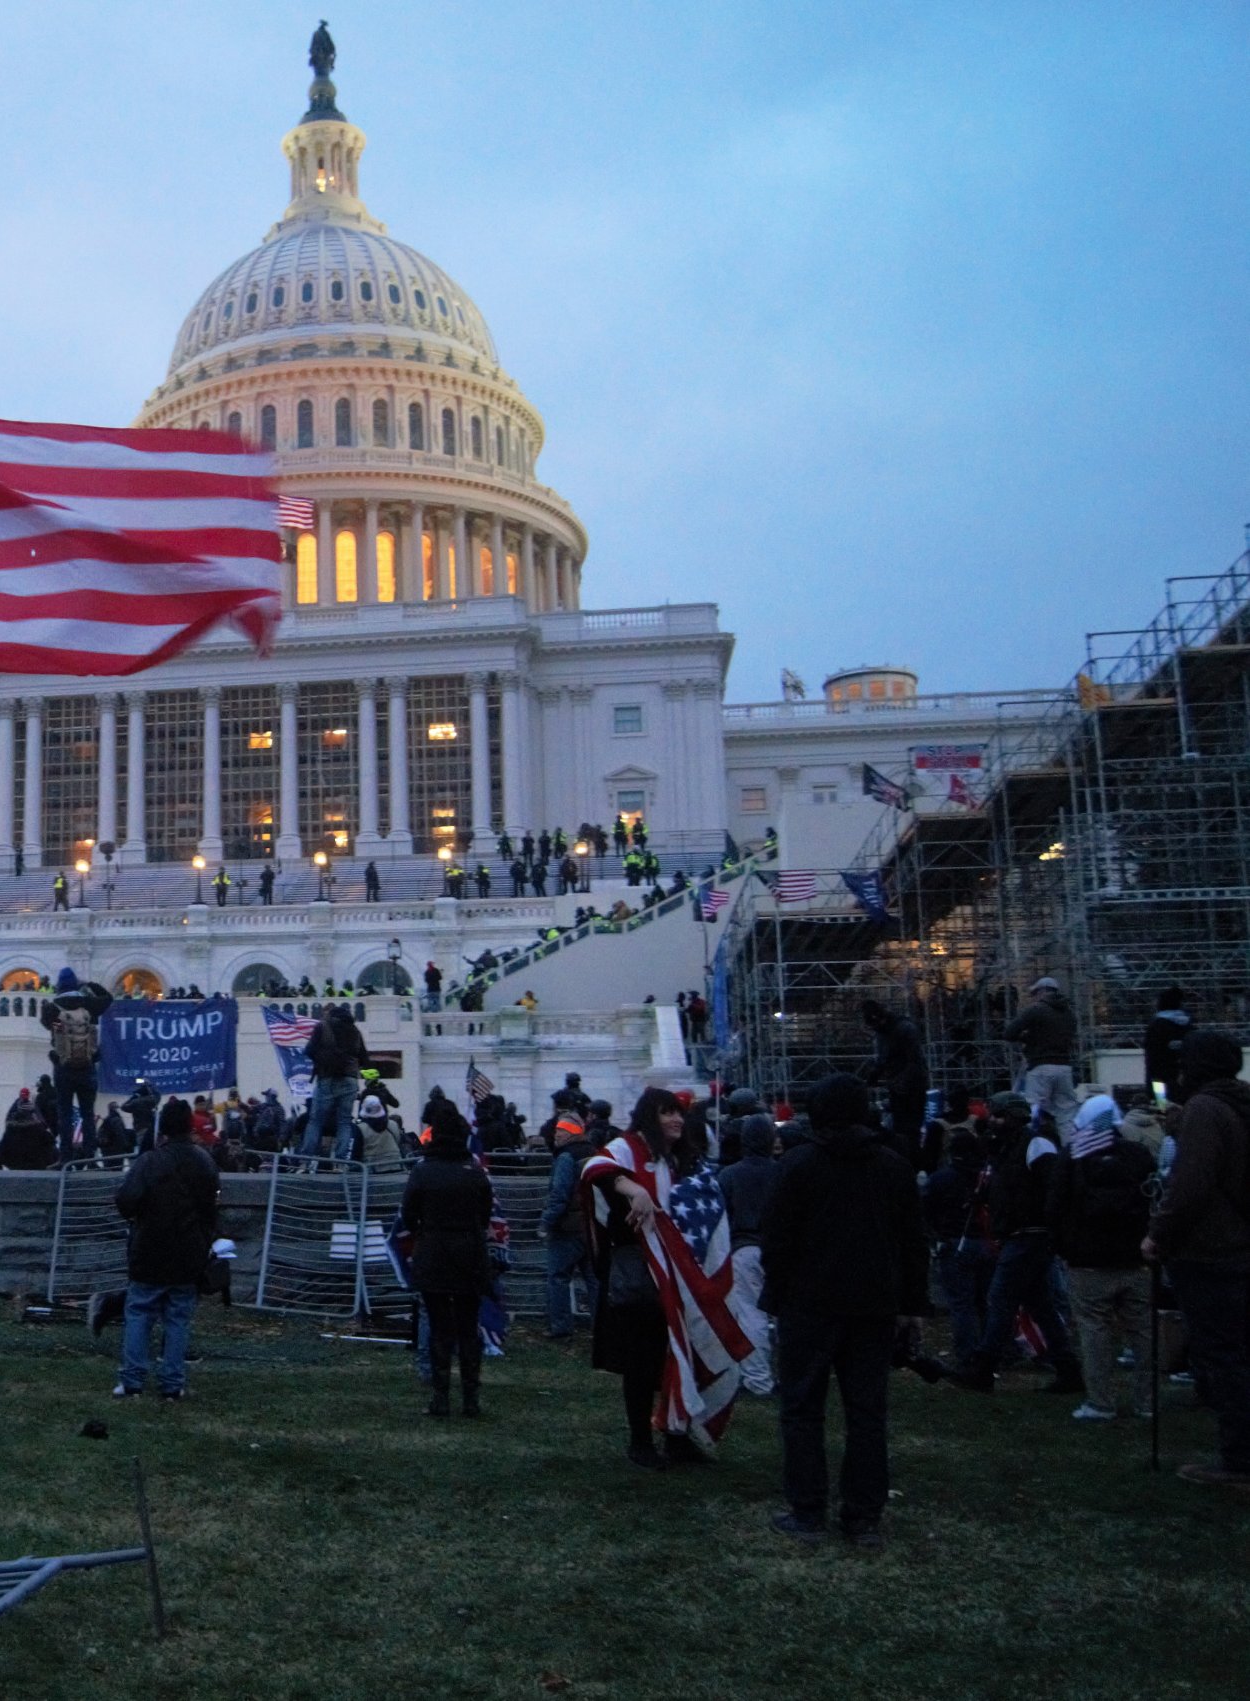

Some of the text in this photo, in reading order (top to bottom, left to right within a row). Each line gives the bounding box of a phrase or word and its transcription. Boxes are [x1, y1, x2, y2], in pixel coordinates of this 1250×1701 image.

[114, 1010, 223, 1040] TRUMP
[143, 1067, 189, 1077] AMERICA
[192, 1061, 225, 1074] GREAT
